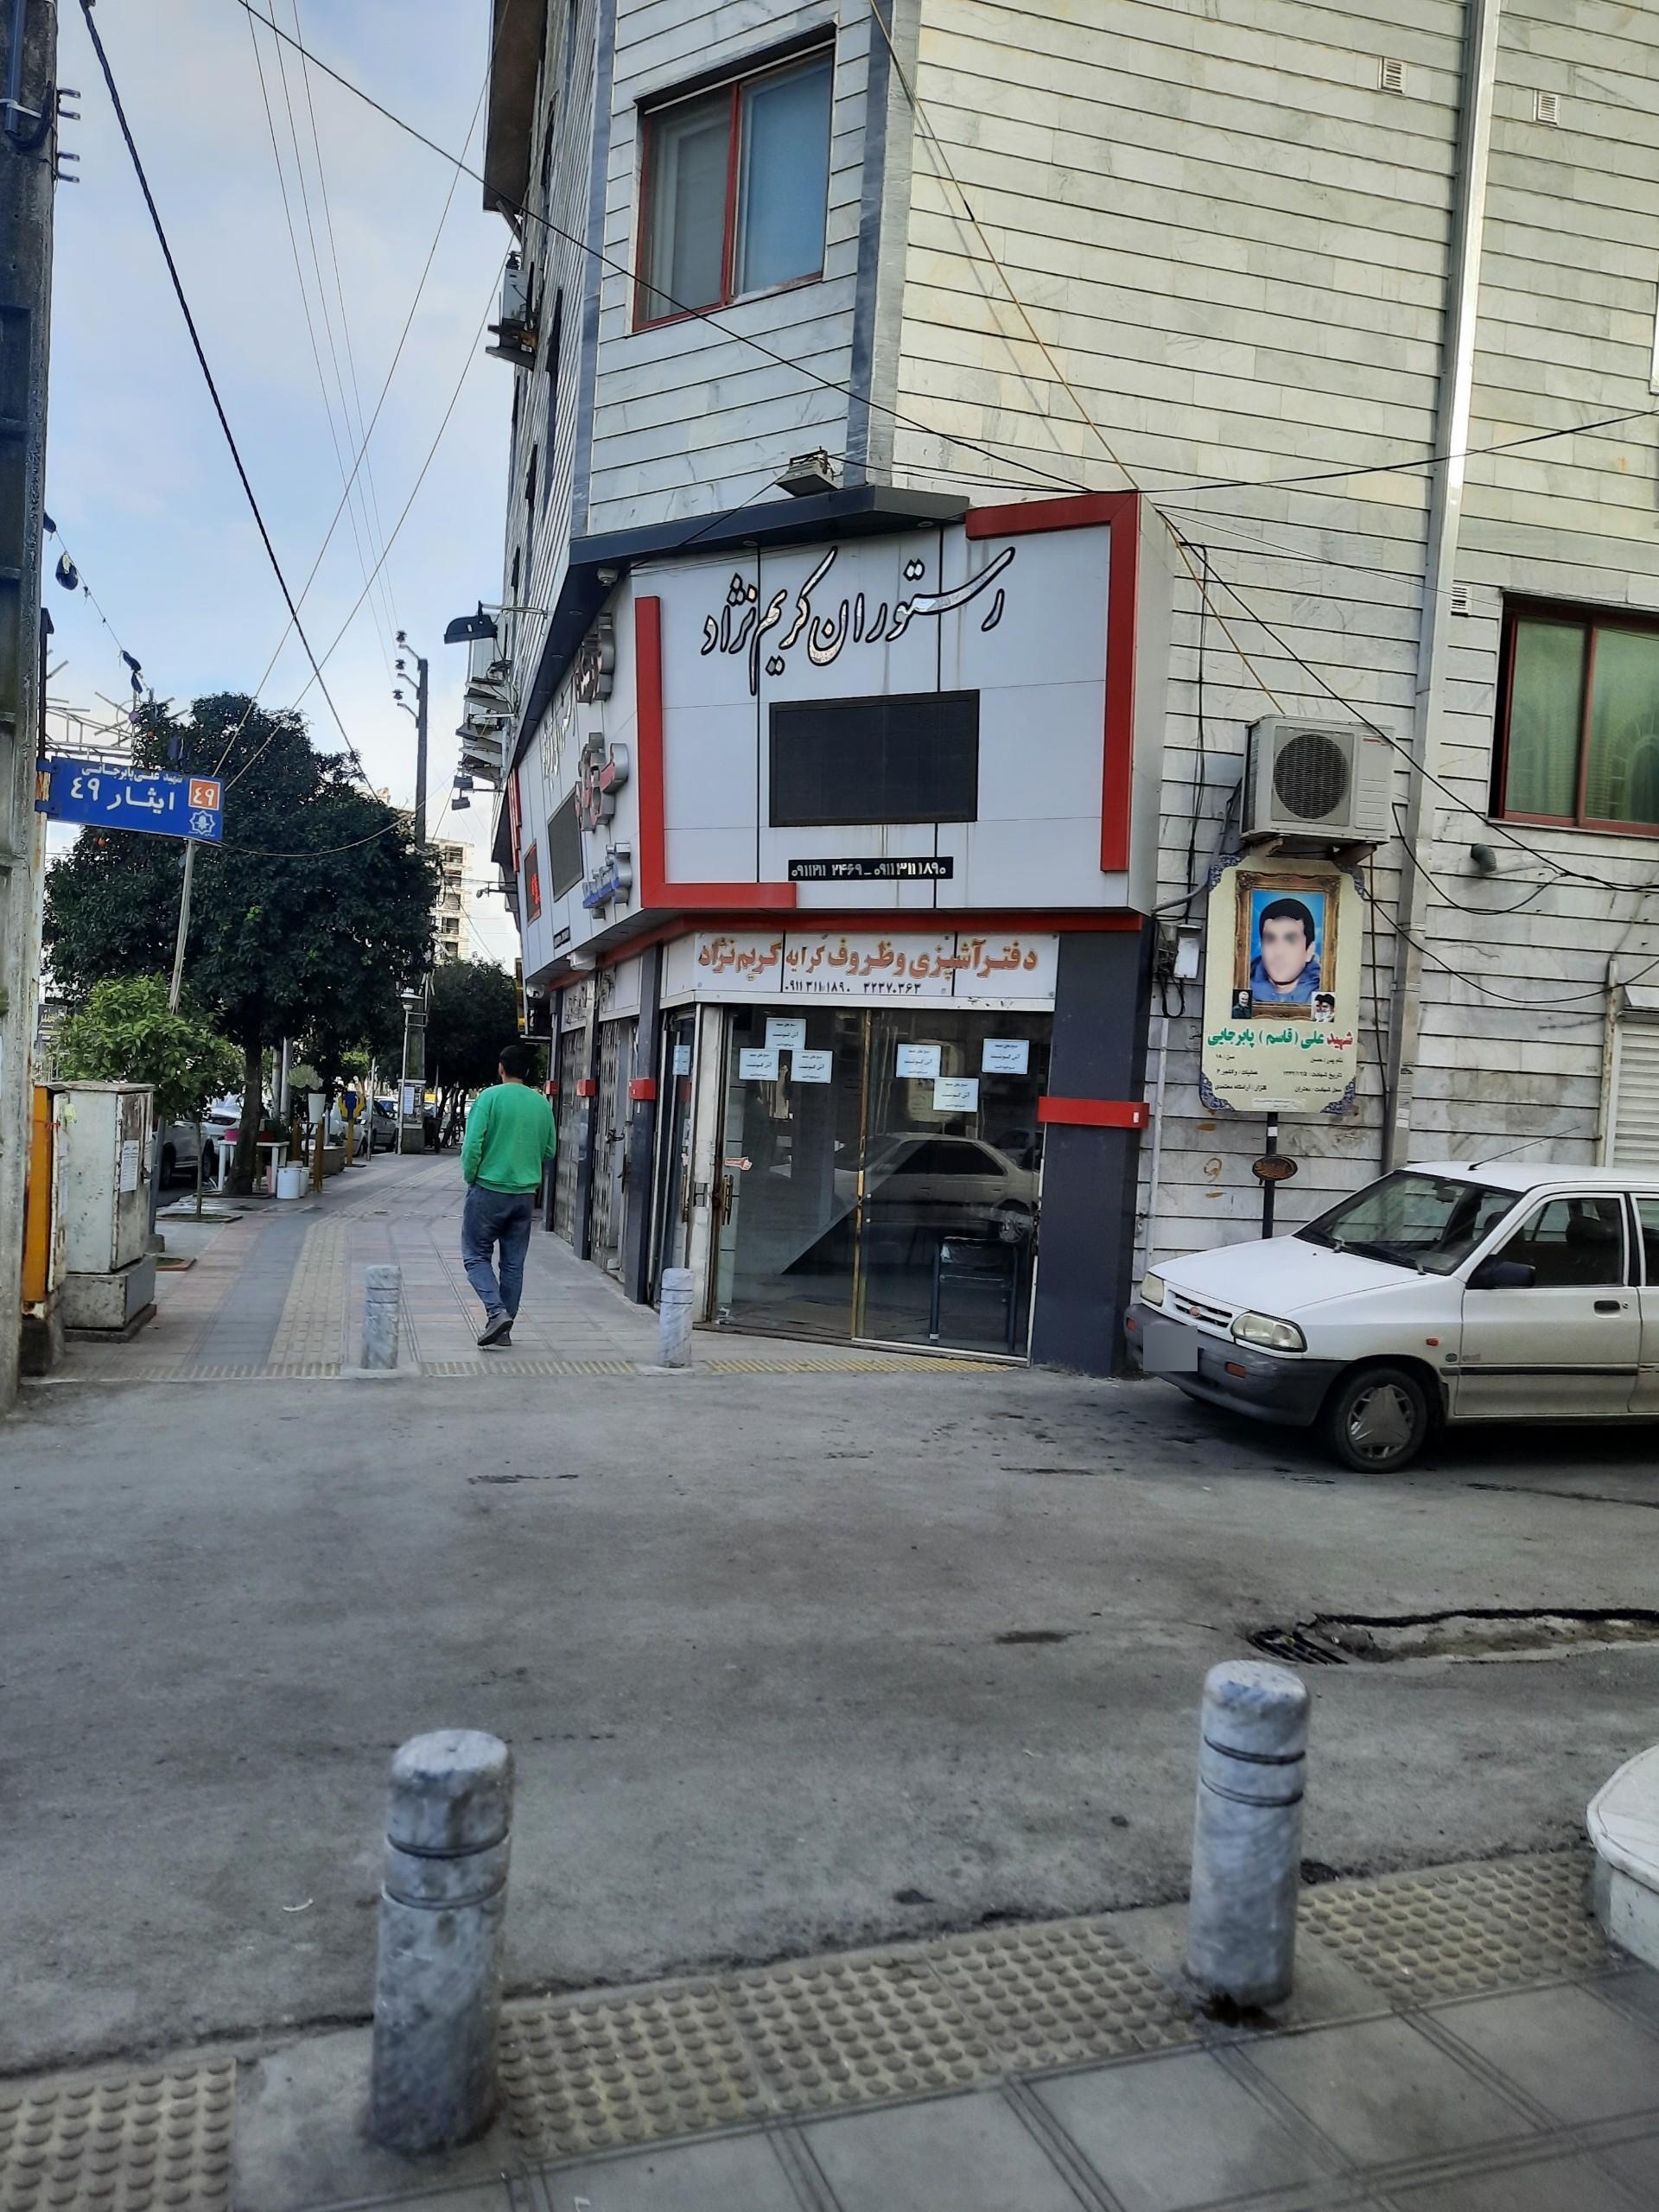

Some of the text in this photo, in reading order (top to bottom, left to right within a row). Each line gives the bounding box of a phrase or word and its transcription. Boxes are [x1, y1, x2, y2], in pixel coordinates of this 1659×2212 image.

[806, 546, 1016, 666] رستوران
[134, 771, 160, 783] علی
[106, 786, 175, 815] ایثار
[1300, 1030, 1325, 1049] علی
[1326, 1031, 1354, 1051] شهید
